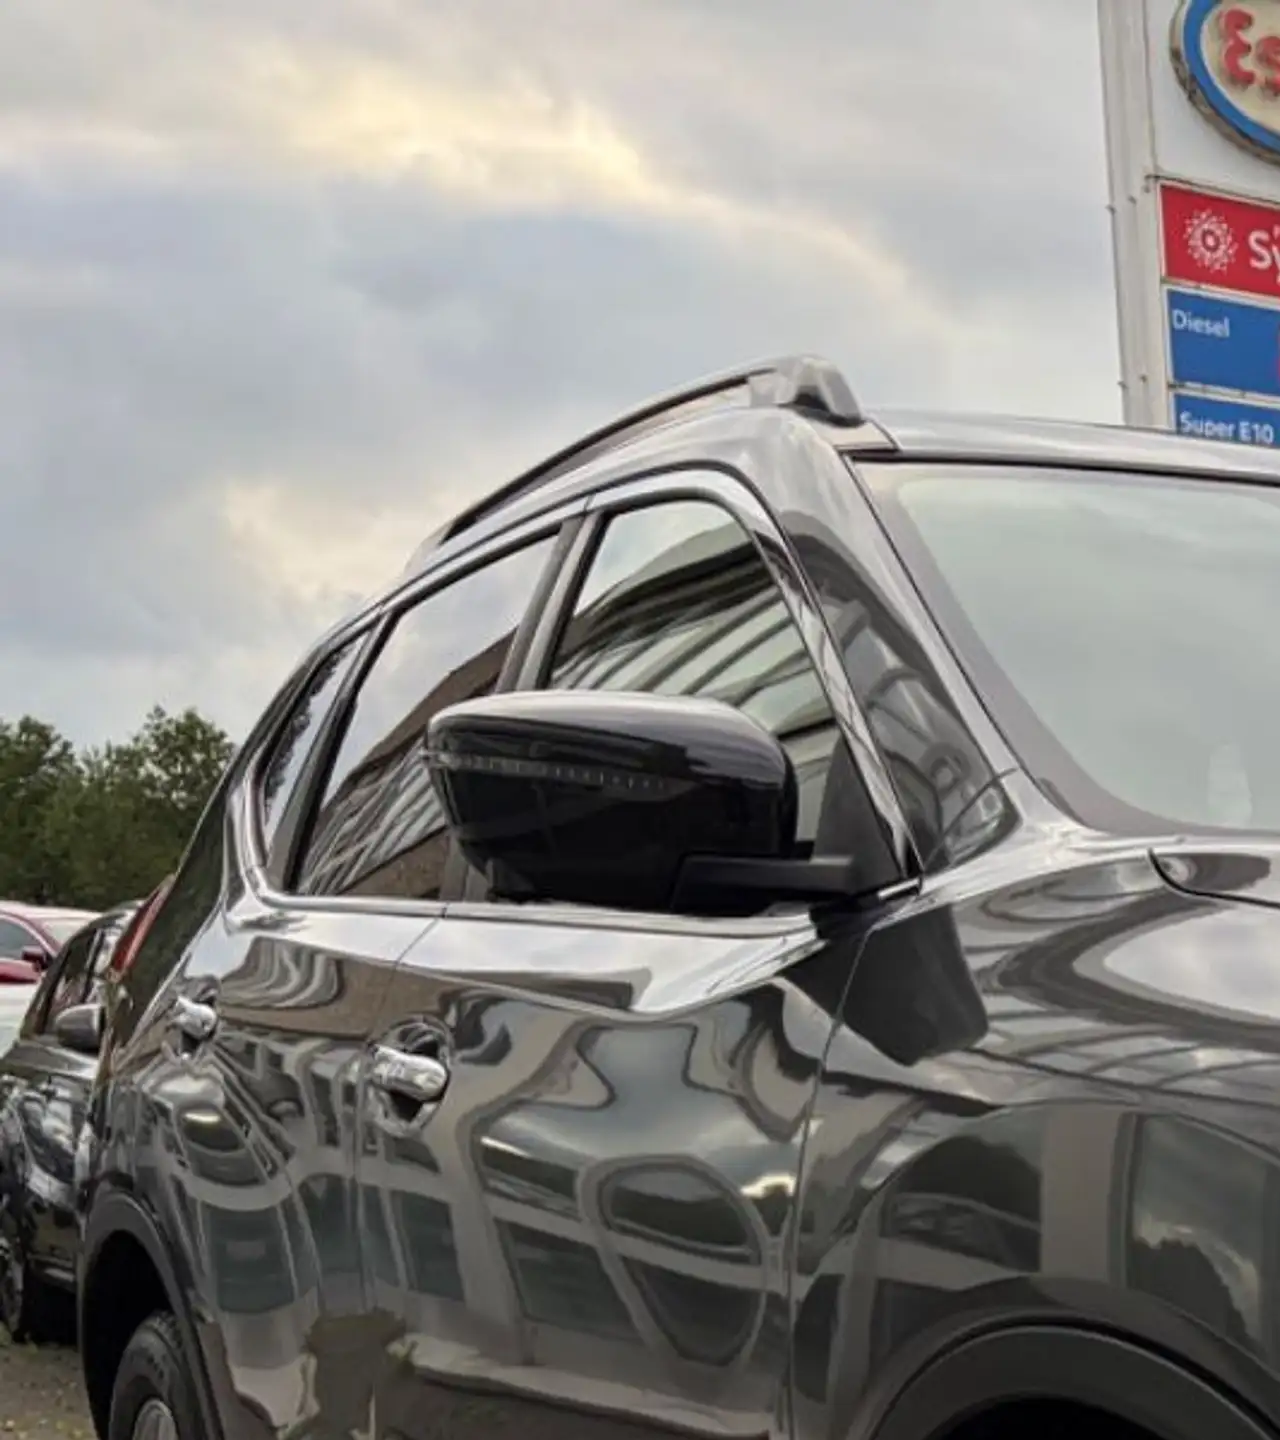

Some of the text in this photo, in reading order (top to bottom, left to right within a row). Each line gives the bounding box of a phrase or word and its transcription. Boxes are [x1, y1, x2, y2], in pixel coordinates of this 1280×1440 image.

[1171, 309, 1230, 338] Diesel
[1179, 410, 1275, 445] Super E10
